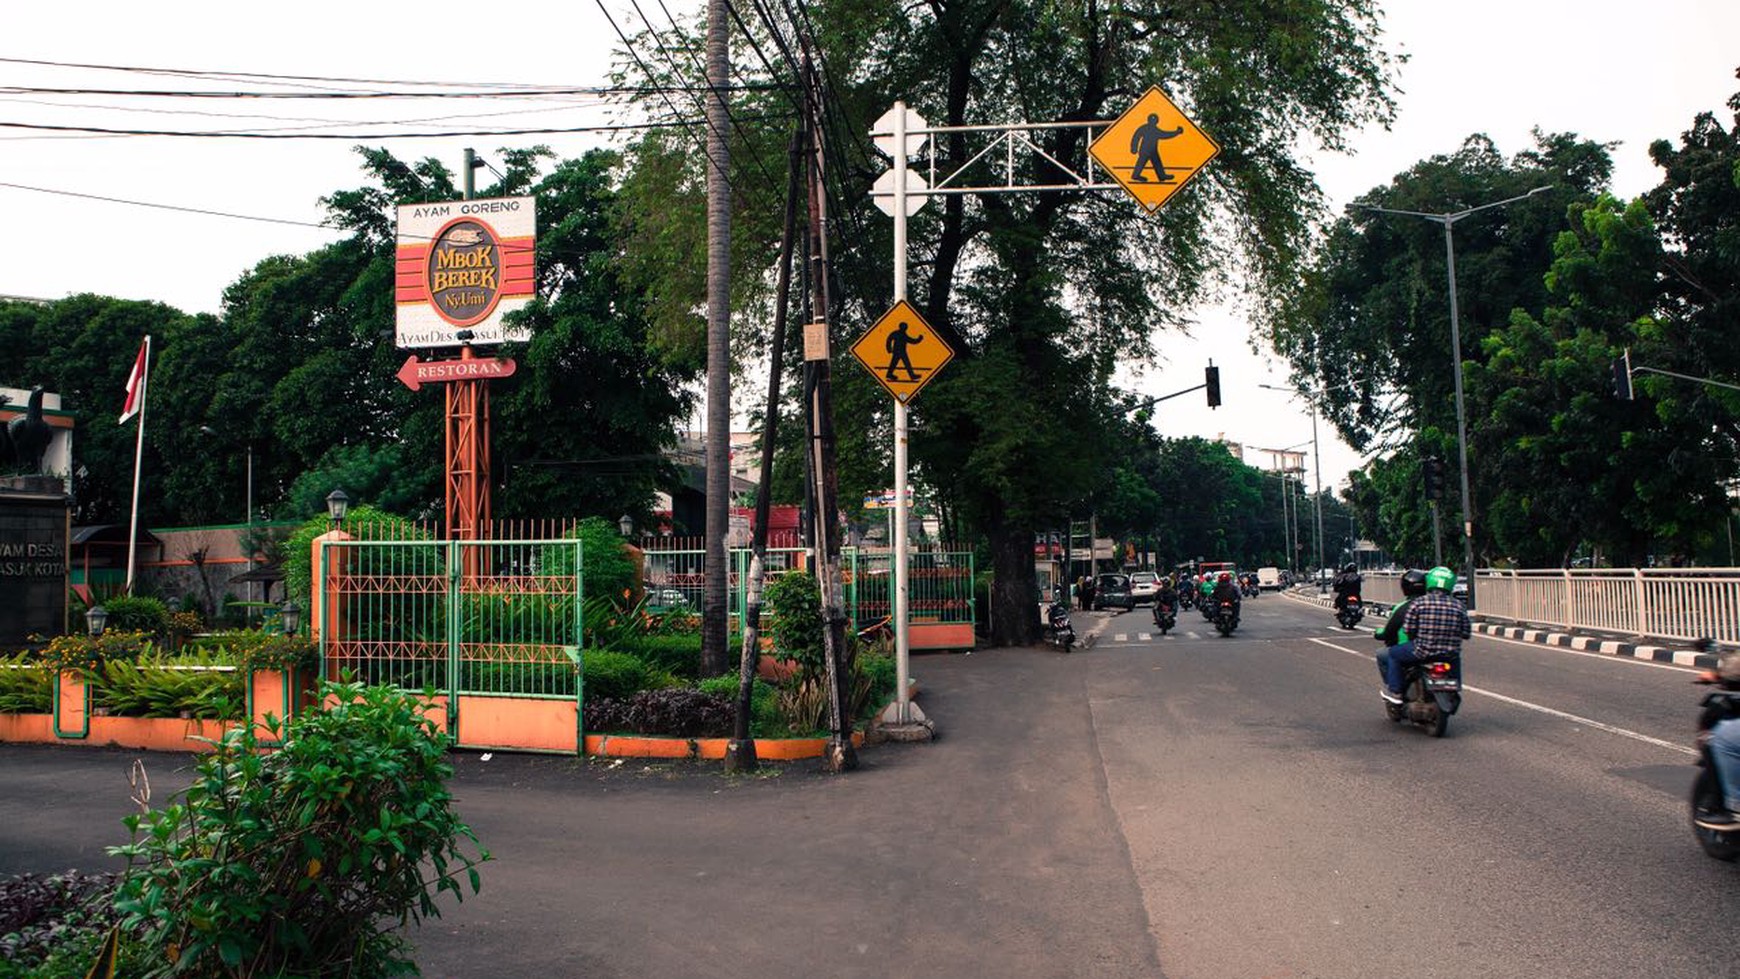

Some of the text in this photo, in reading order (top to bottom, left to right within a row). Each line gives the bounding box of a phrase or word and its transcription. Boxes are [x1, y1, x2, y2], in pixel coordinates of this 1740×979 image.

[413, 201, 520, 219] AYAM GORENG
[437, 245, 493, 270] MBOK
[432, 267, 498, 293] BEREK
[430, 330, 459, 343] DES
[417, 362, 501, 378] RESTORAN
[28, 543, 63, 557] DESA
[35, 561, 66, 576] KOTA
